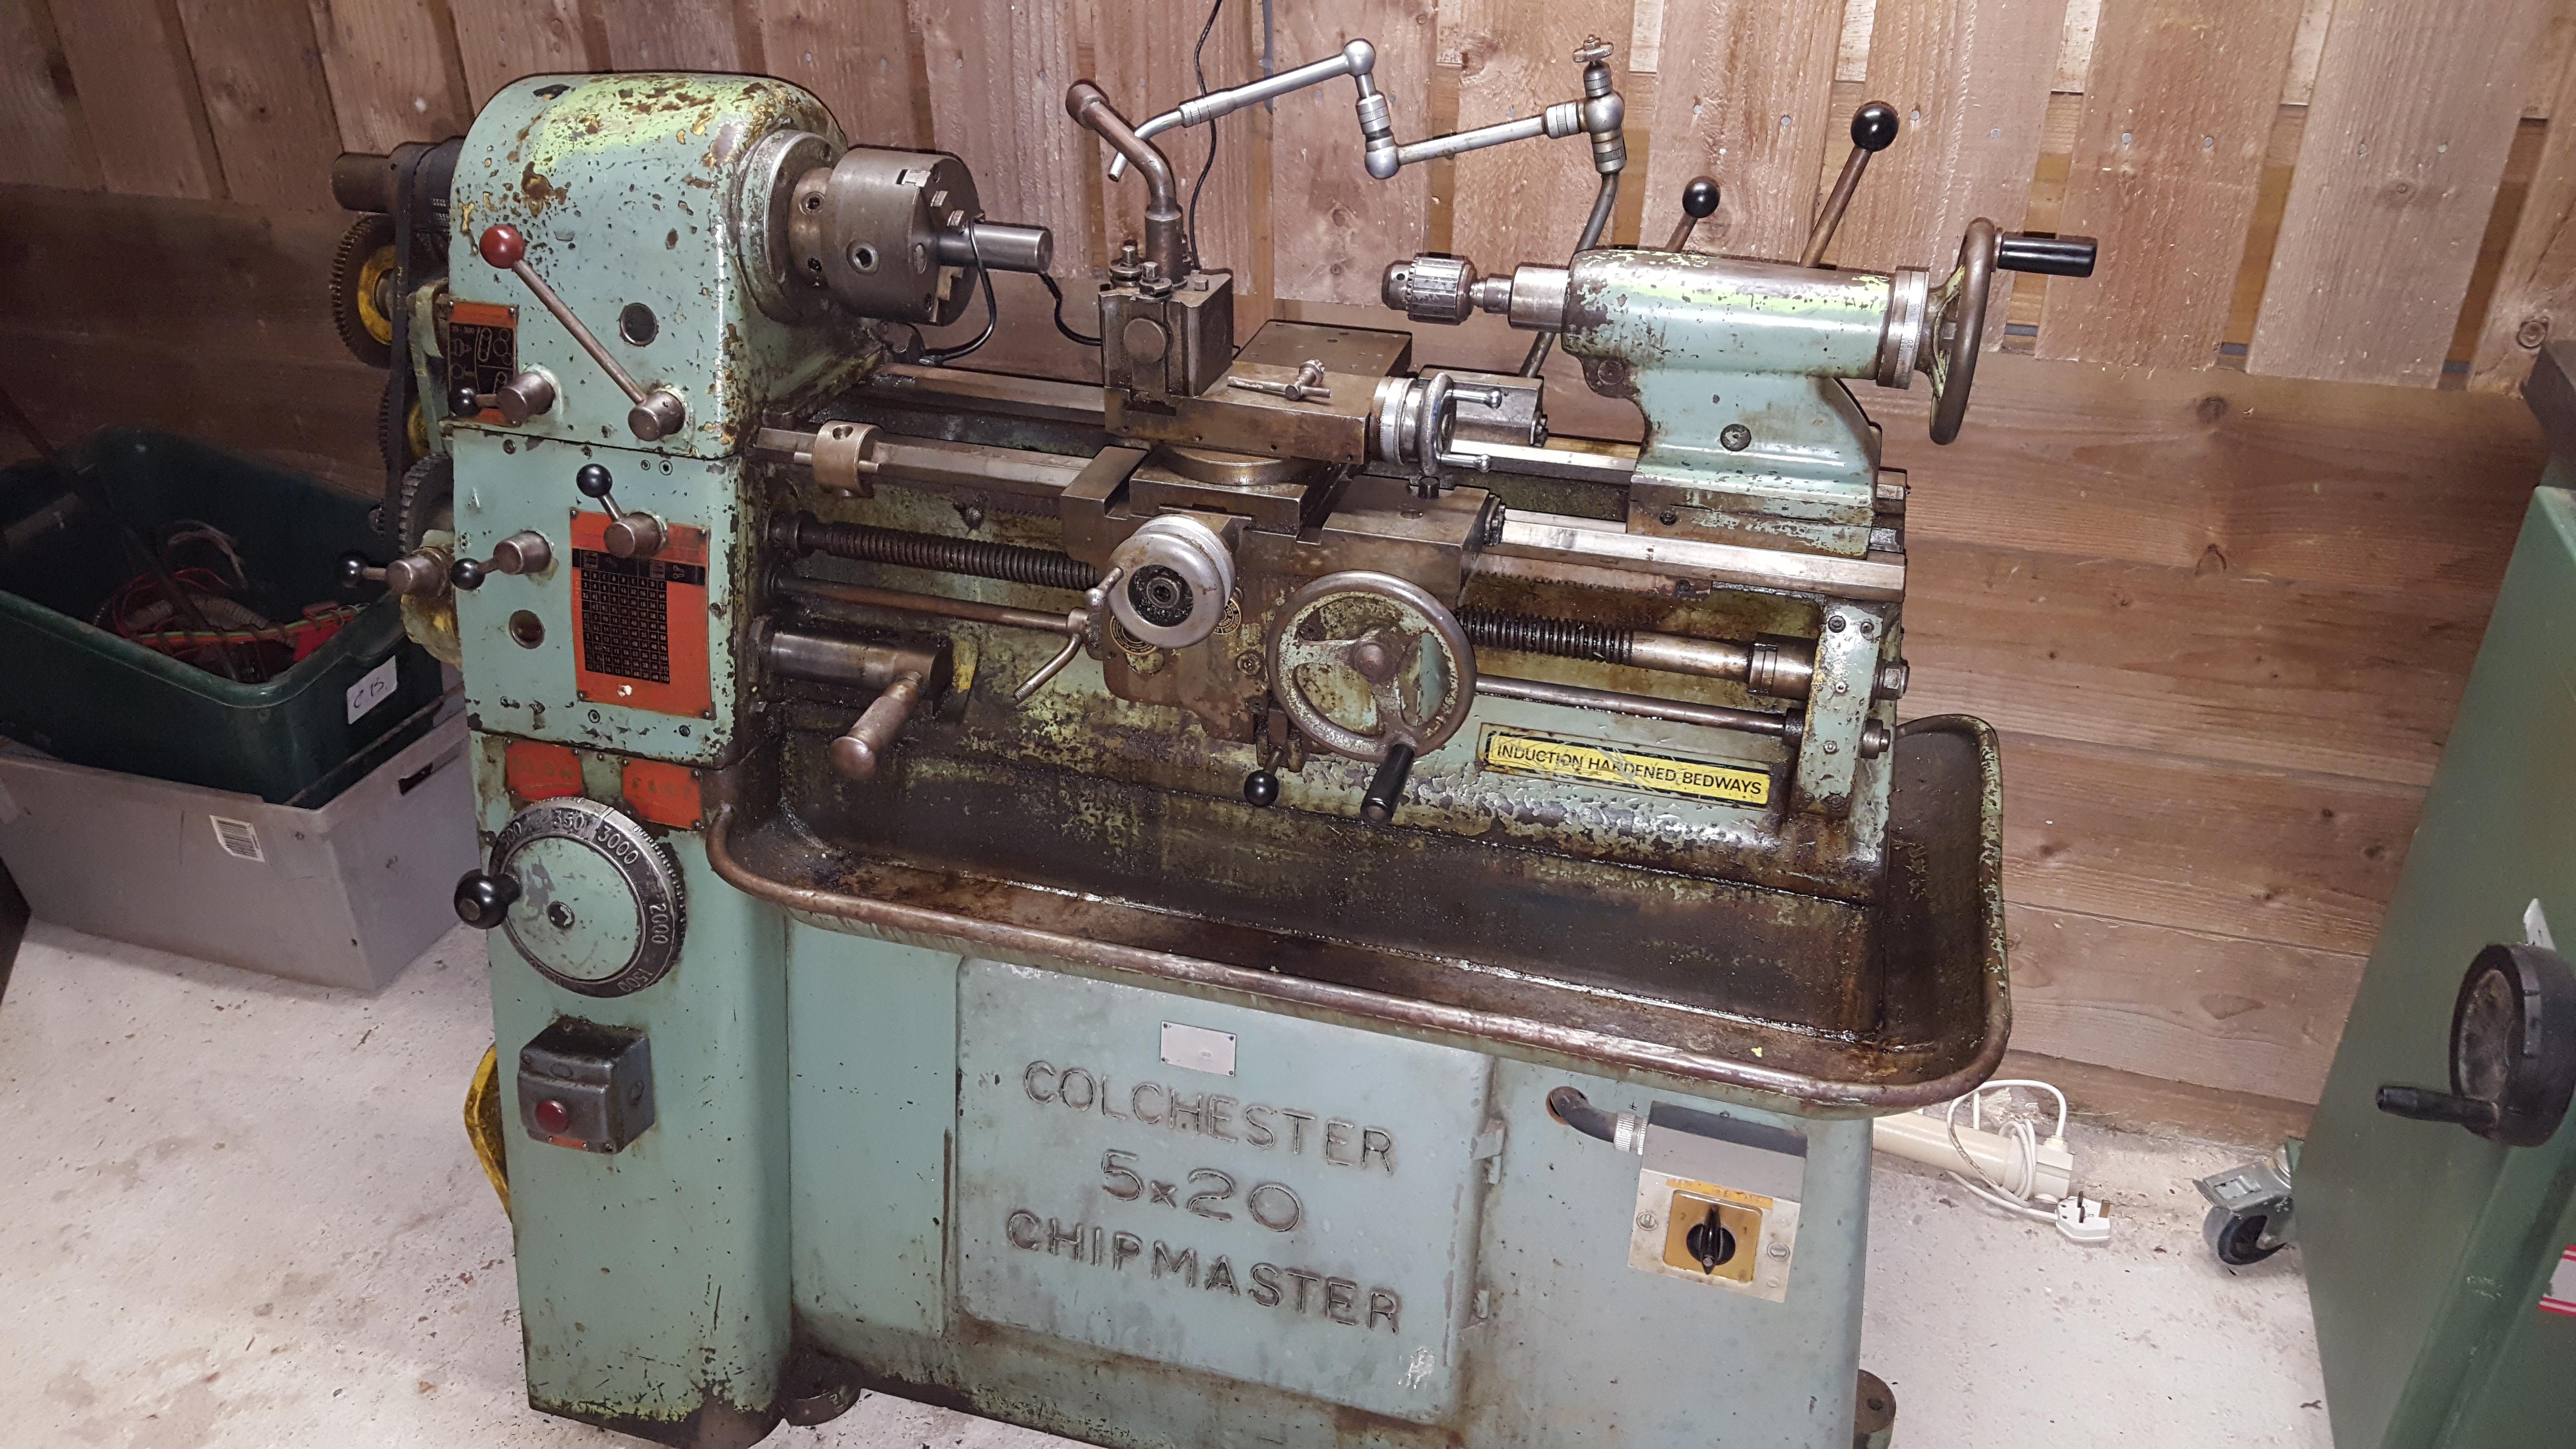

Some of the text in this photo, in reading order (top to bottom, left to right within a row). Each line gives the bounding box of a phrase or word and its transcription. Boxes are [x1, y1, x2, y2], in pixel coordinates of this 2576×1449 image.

[1907, 339, 1914, 348] 20
[1497, 744, 1583, 768] INDUCTION
[1682, 771, 1762, 794] BEDWAYS
[554, 809, 584, 831] 350
[597, 825, 639, 865] 3000
[649, 903, 669, 944] 2000
[617, 968, 653, 992] 1500
[1023, 1061, 1393, 1175] COLCHESTER
[1007, 1209, 1400, 1335] CHIPMASTER
